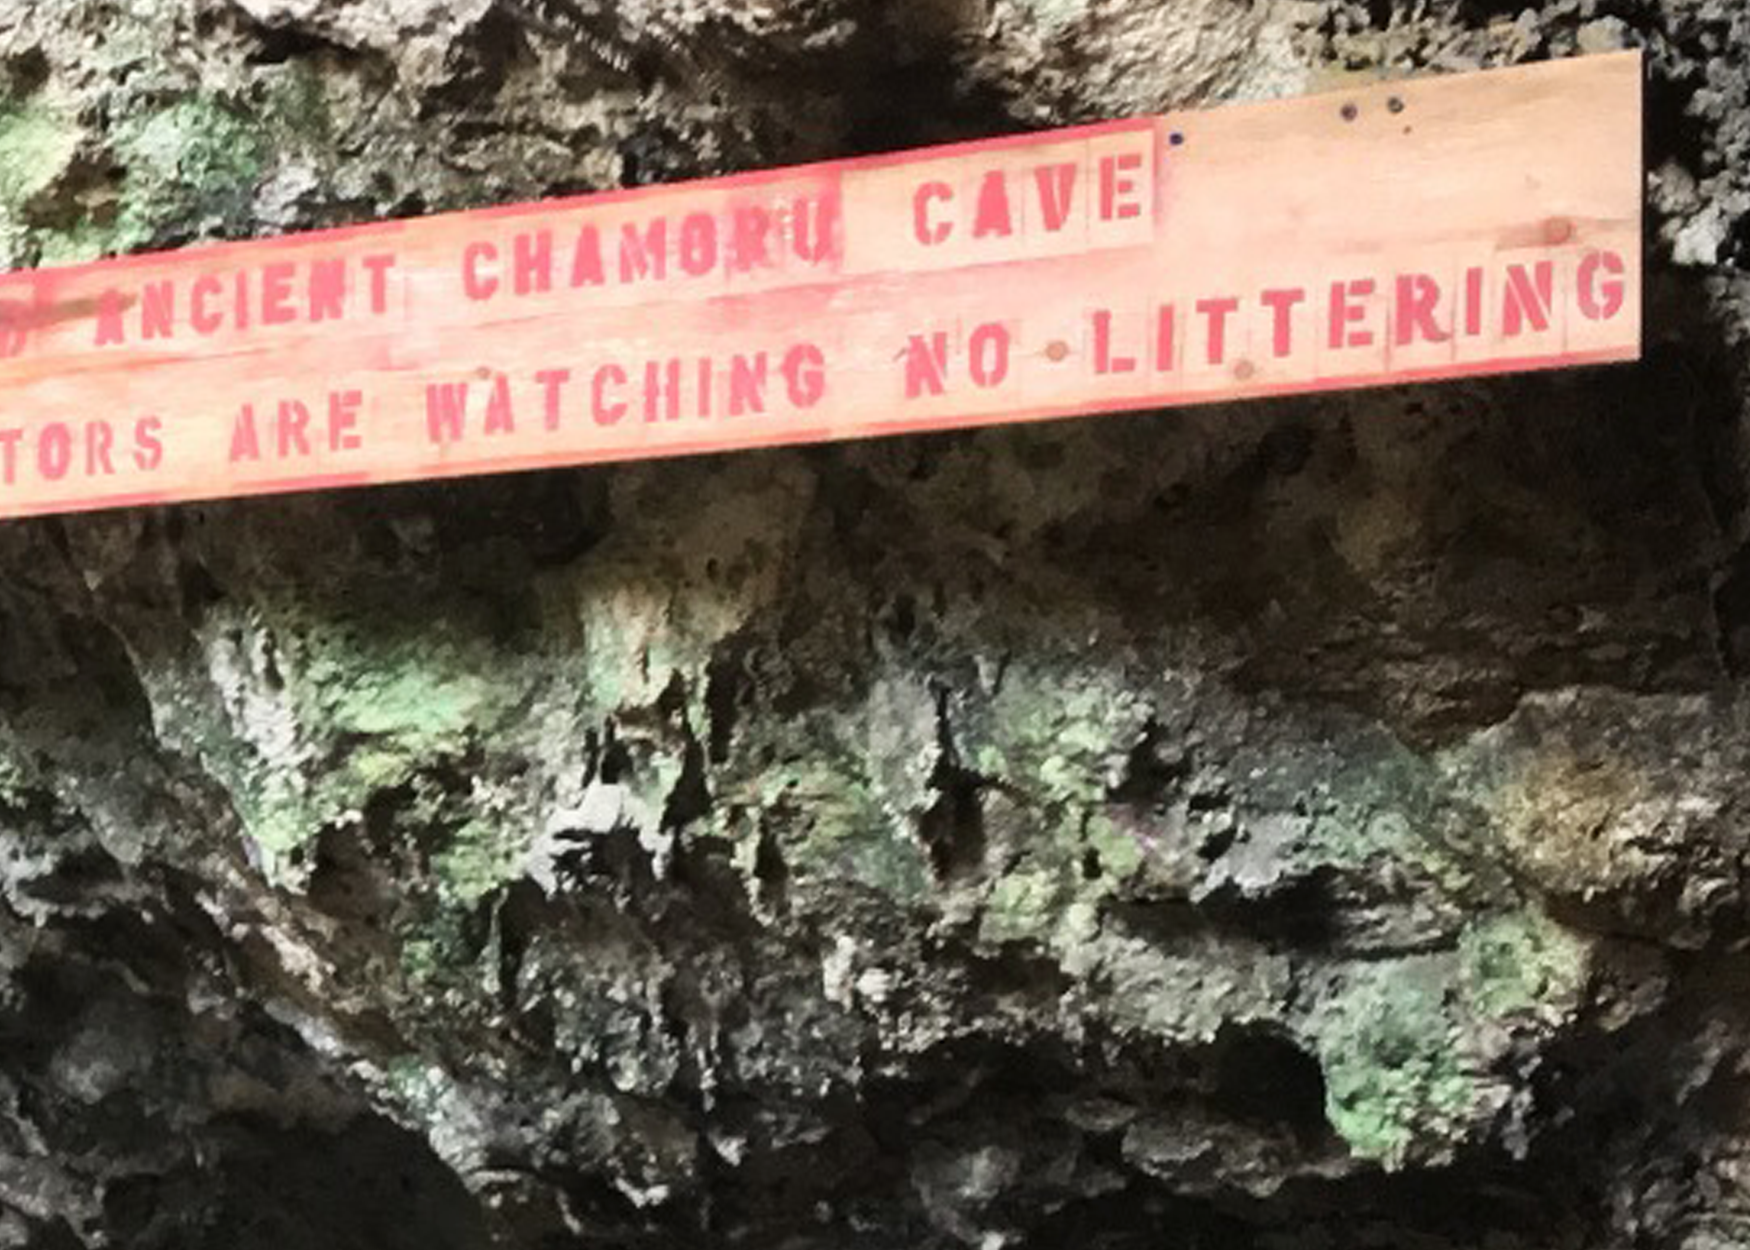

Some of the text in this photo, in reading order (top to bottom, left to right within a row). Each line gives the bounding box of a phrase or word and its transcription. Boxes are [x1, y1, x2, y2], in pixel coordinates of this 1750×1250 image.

[93, 255, 396, 347] ANCIENT
[912, 154, 1143, 246] CAVE
[228, 390, 363, 462] ARE
[425, 343, 826, 444] WATCHING
[904, 322, 1011, 399] NO
[1090, 250, 1627, 375] LITTERING
